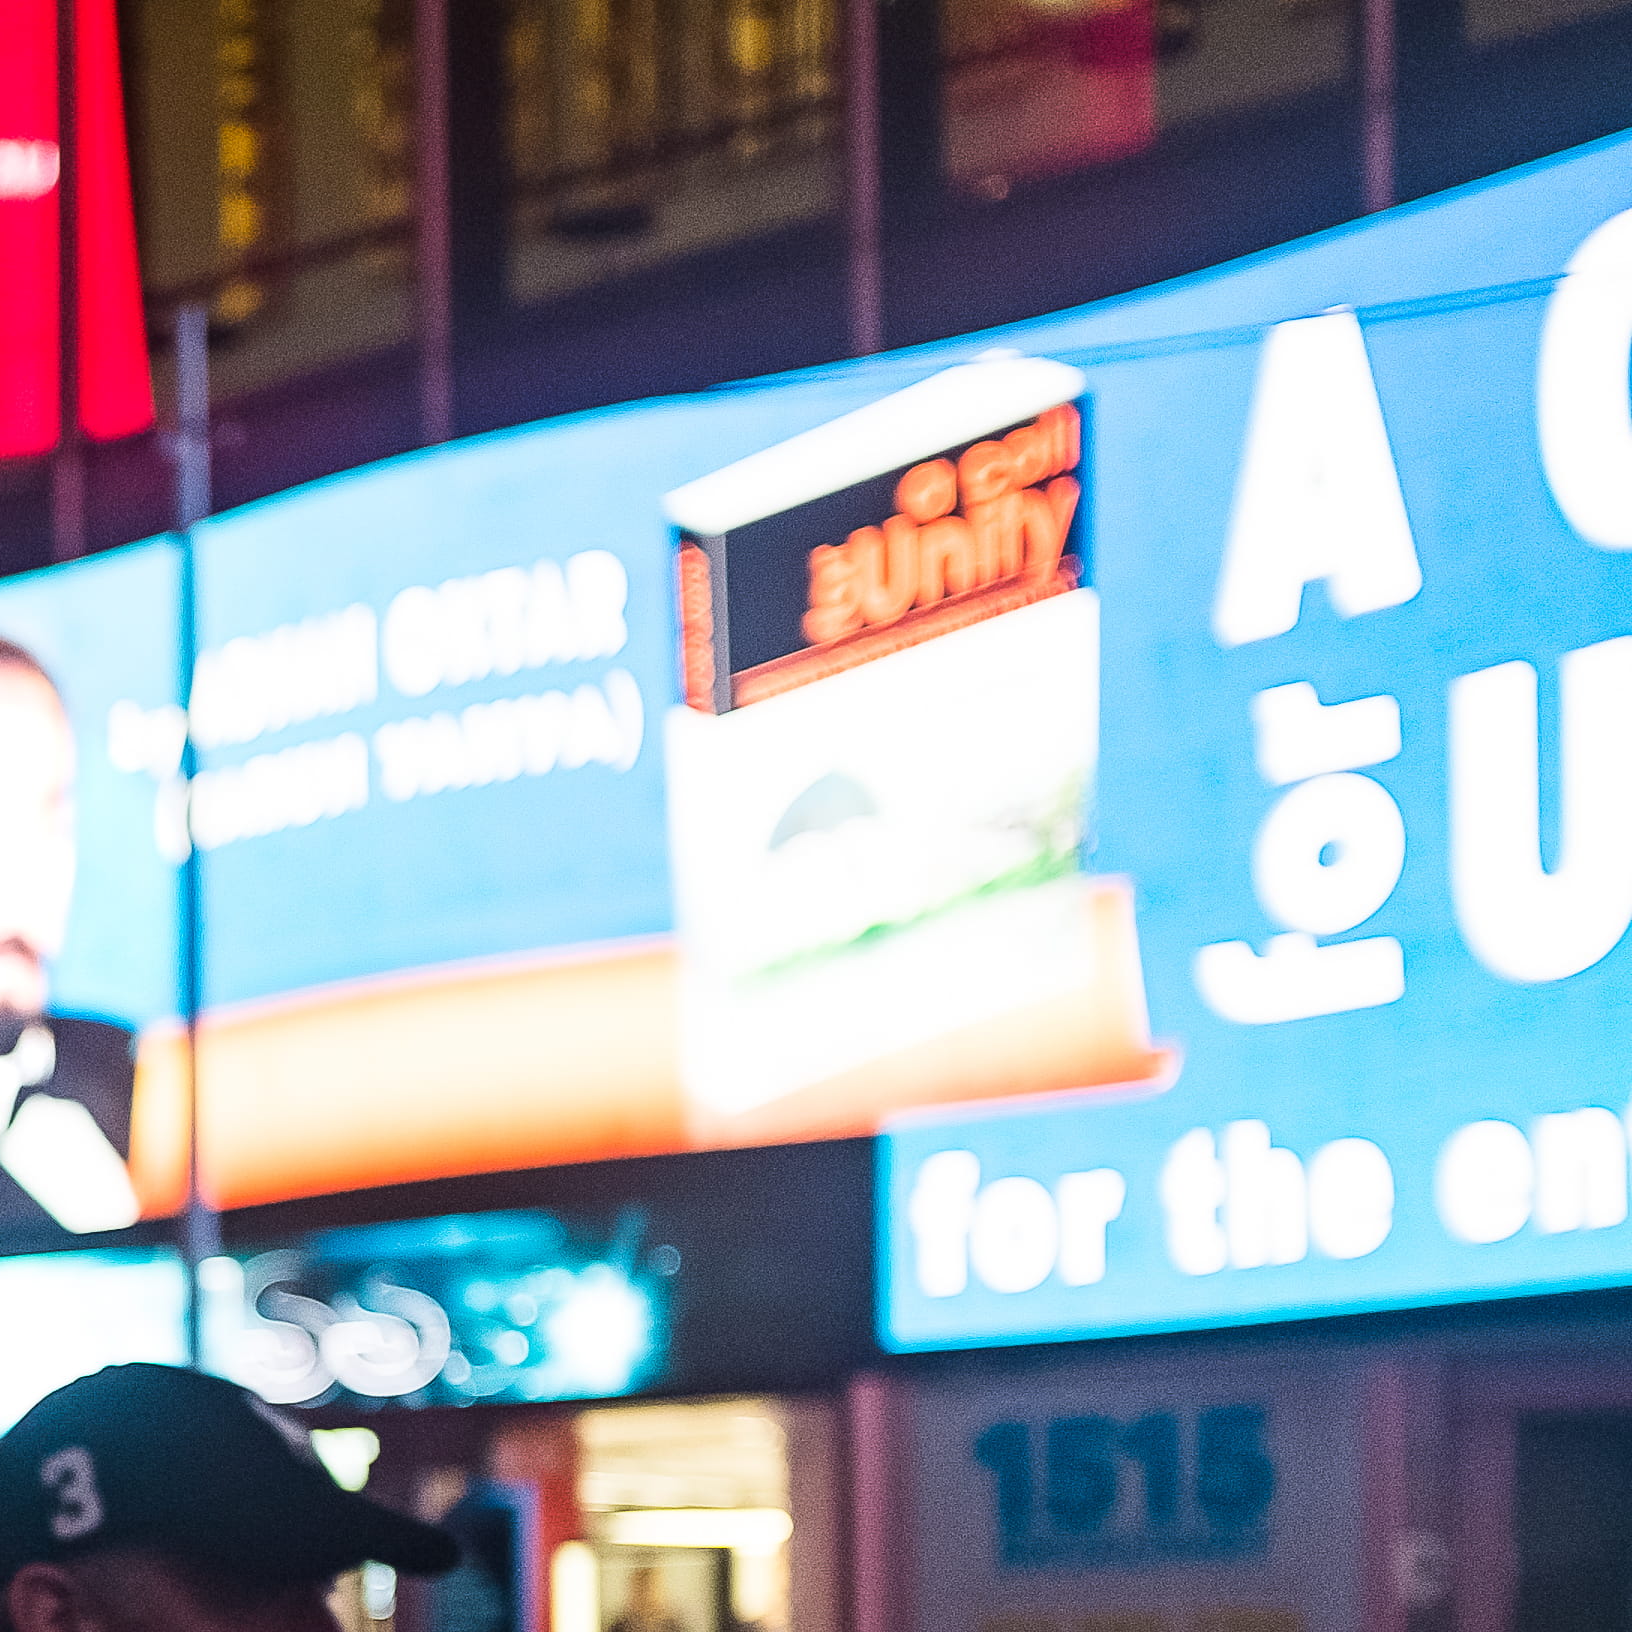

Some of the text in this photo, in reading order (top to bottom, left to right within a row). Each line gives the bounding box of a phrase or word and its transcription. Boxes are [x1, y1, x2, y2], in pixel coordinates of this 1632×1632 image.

[1213, 308, 1424, 648] A
[910, 1100, 1632, 1298] for the en
[41, 1446, 104, 1541] 3
